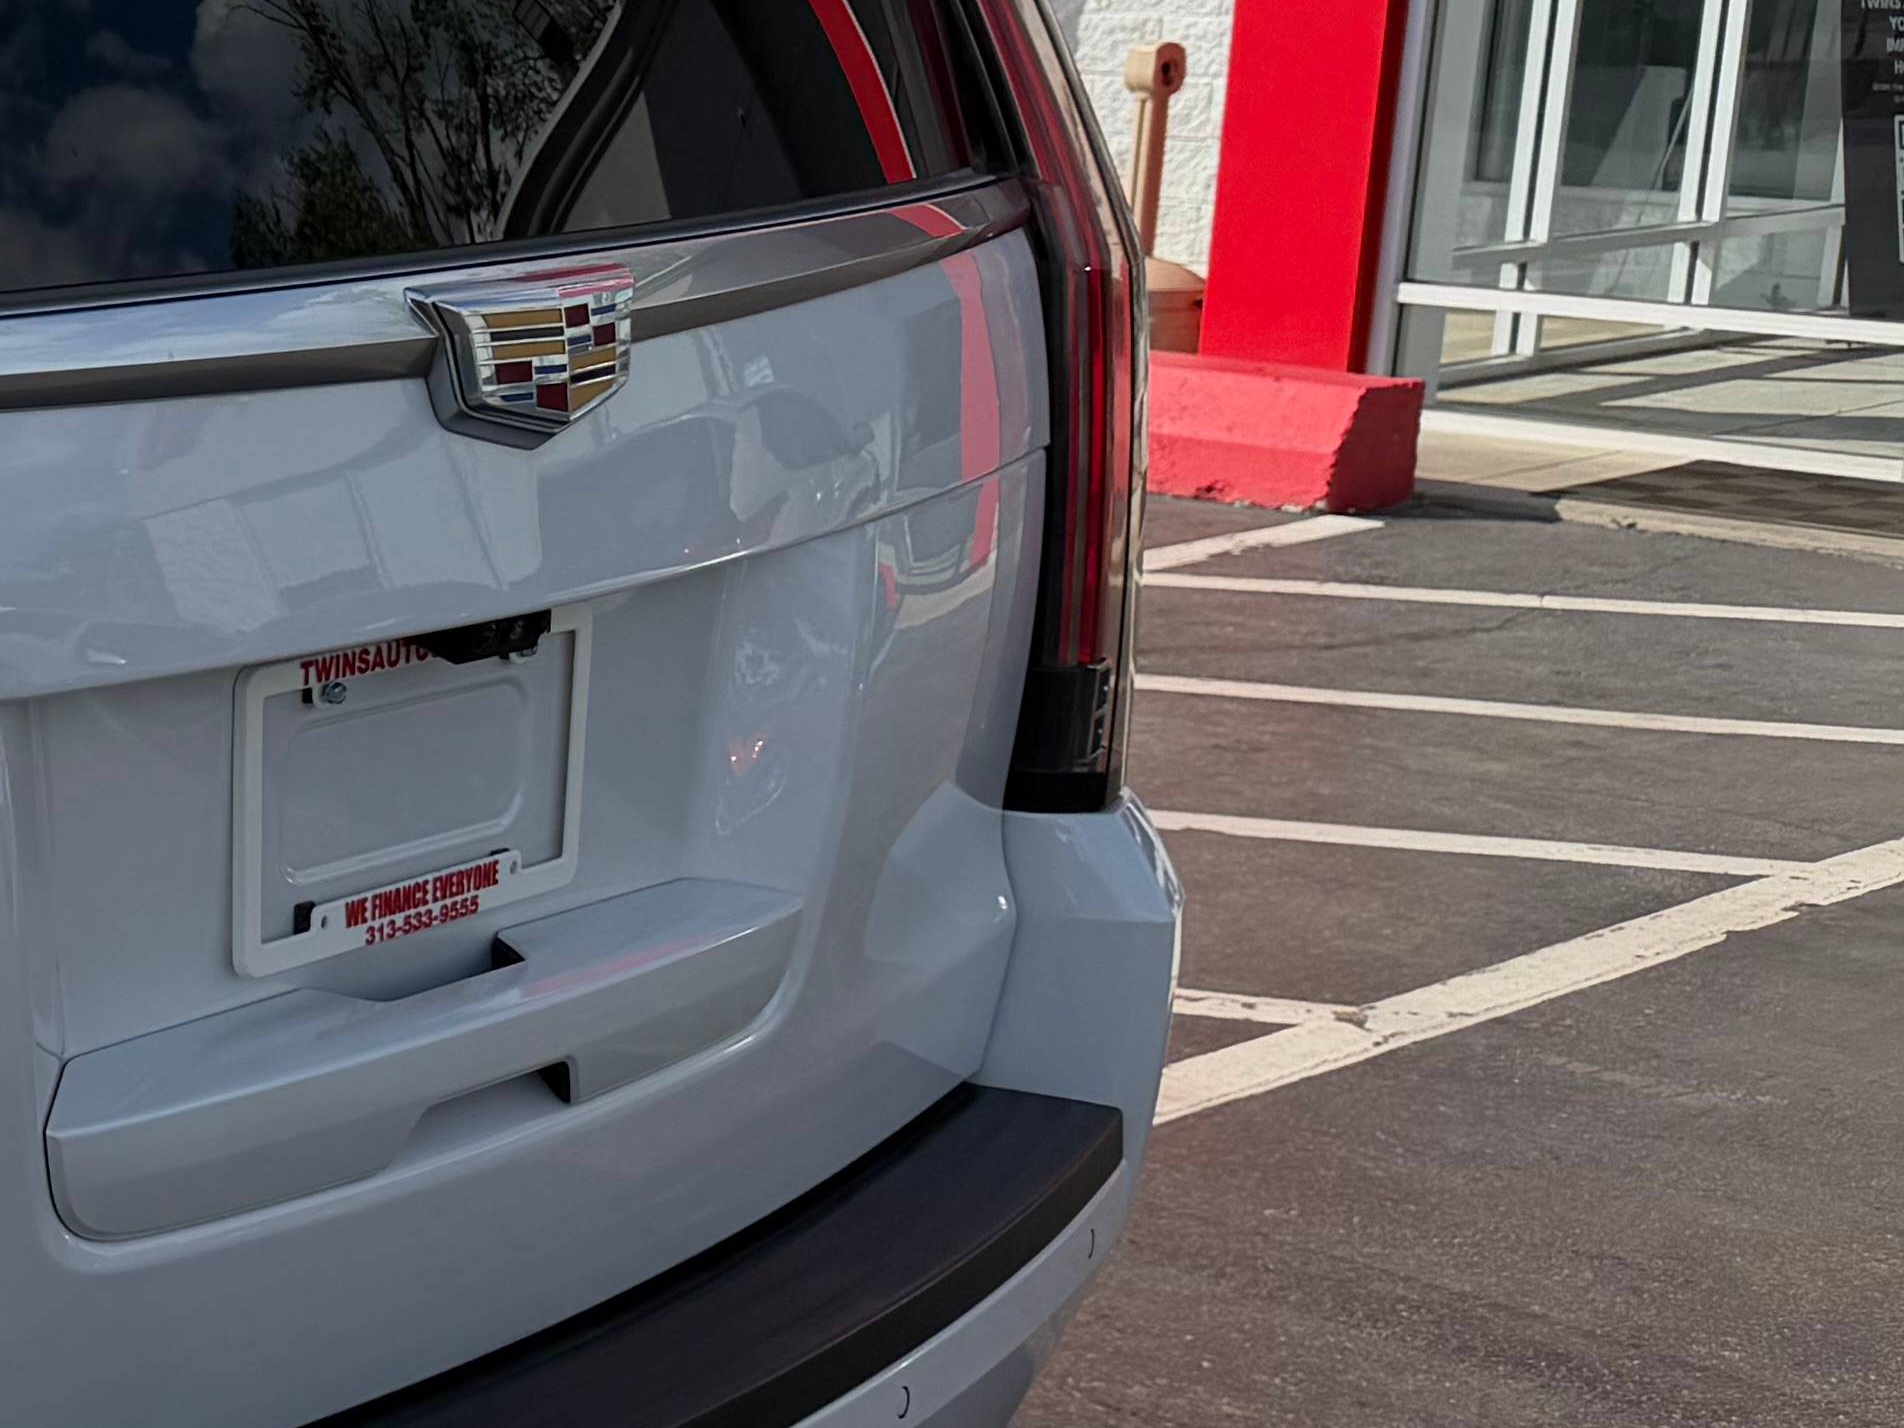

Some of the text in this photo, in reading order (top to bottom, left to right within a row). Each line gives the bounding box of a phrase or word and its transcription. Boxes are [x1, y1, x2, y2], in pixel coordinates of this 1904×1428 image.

[300, 638, 435, 686] TWINSAUTO
[345, 859, 500, 928] WE FINANCE EVERYONE
[365, 894, 480, 946] 313-533-9555
